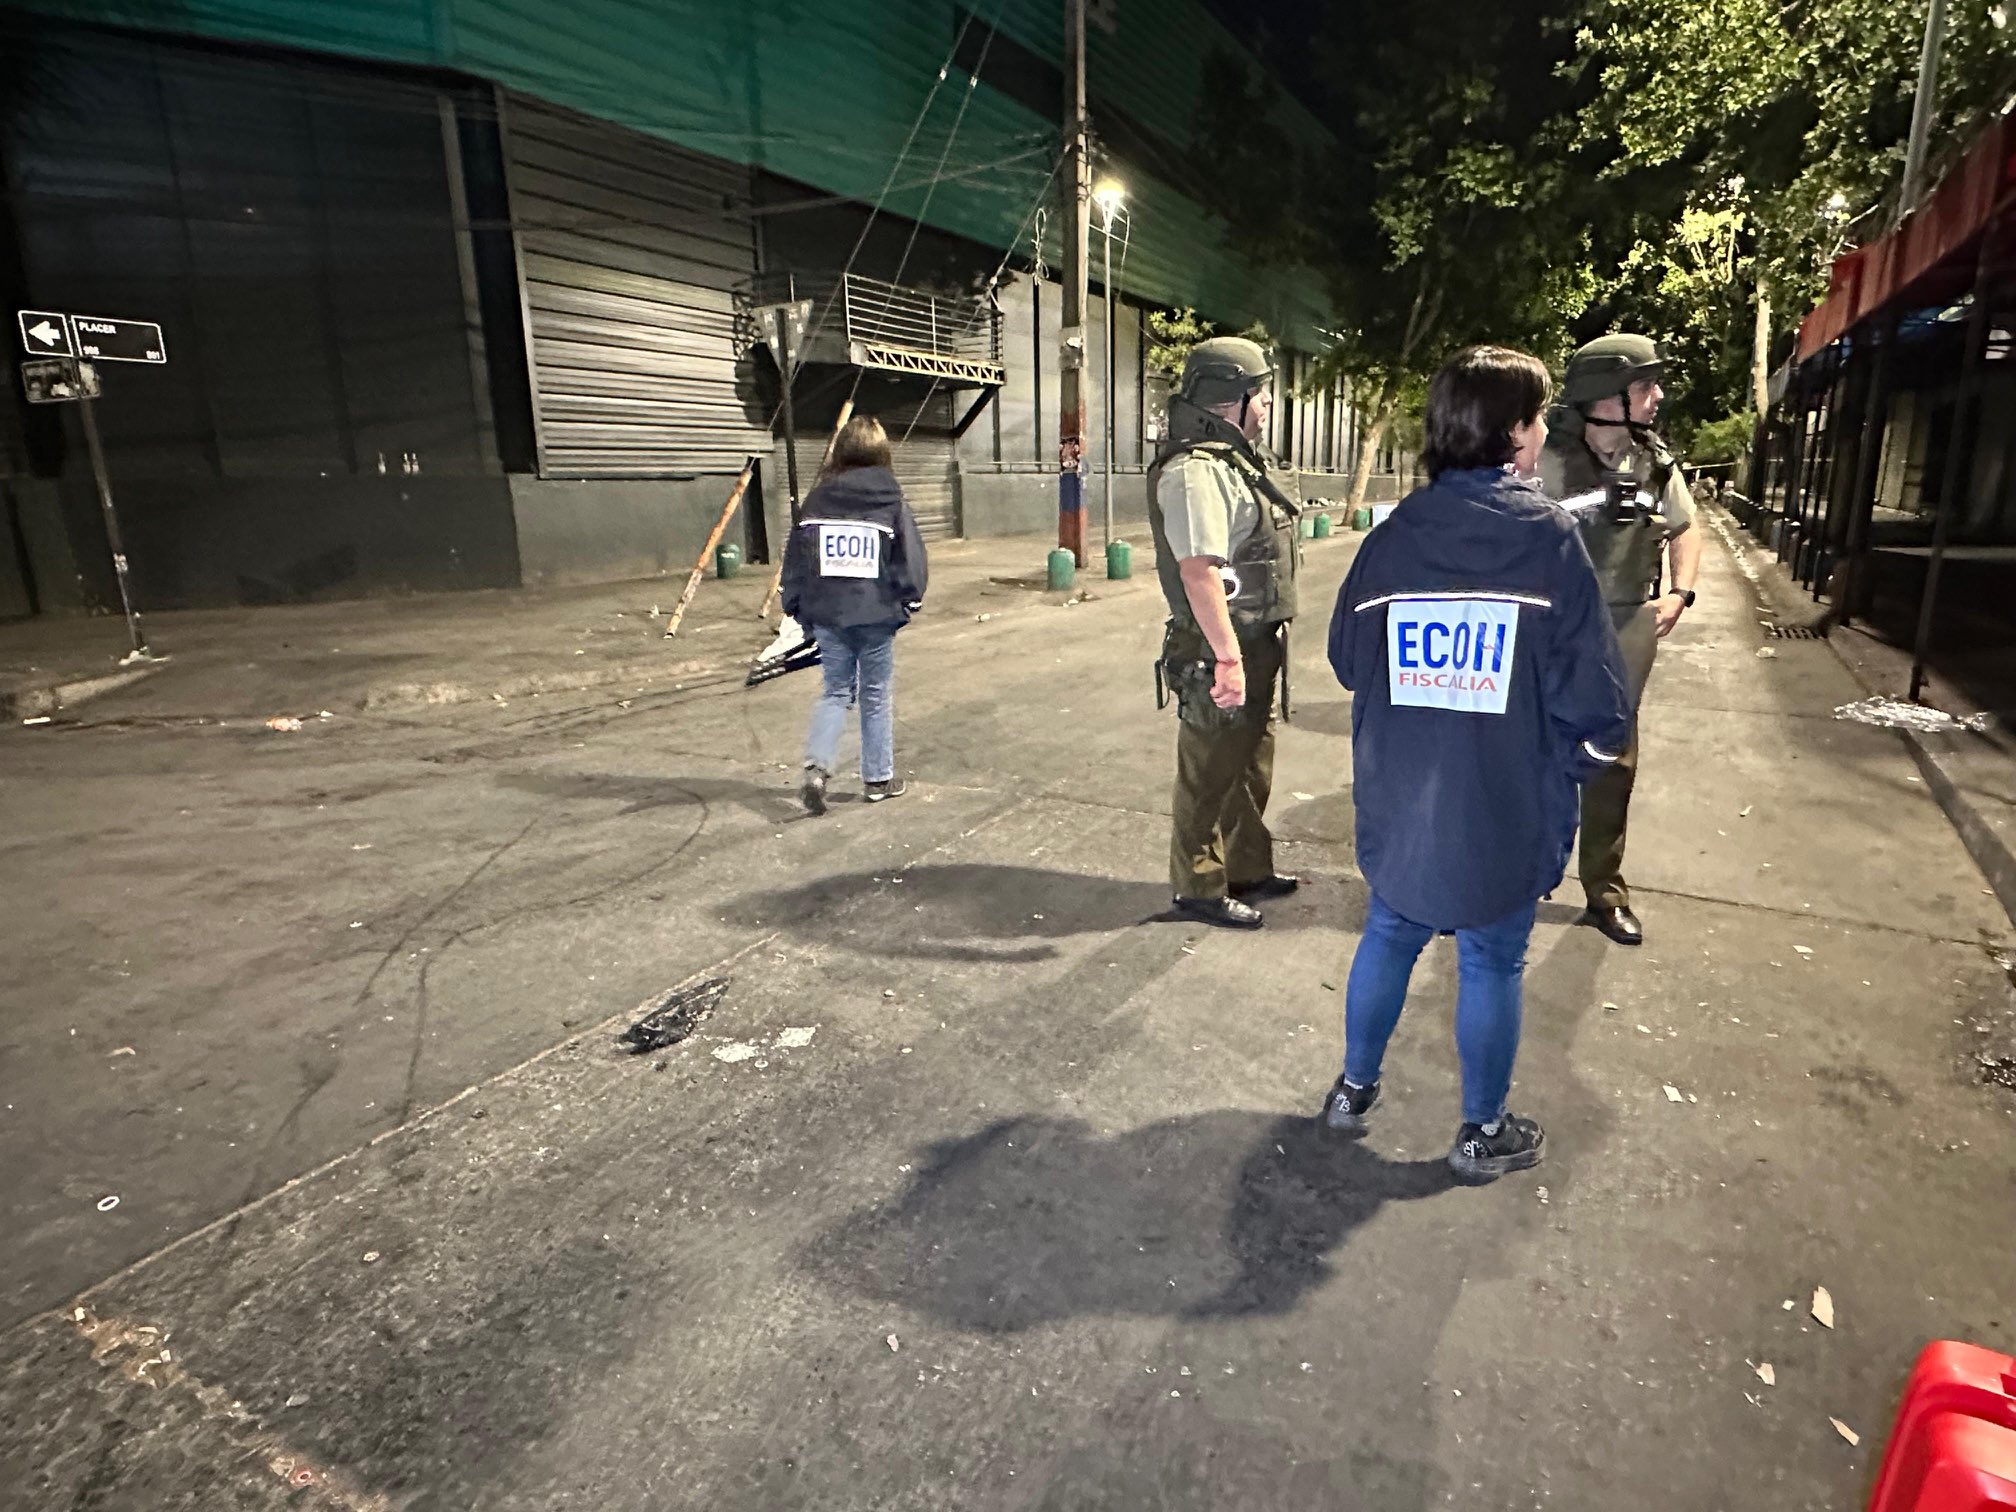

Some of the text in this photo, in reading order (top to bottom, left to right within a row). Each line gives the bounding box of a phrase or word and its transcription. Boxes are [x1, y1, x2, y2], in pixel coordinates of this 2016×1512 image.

[79, 321, 117, 334] PLACER
[825, 535, 875, 560] ECOH
[1397, 621, 1506, 673] ECOH
[1399, 672, 1497, 692] FISCALIA
